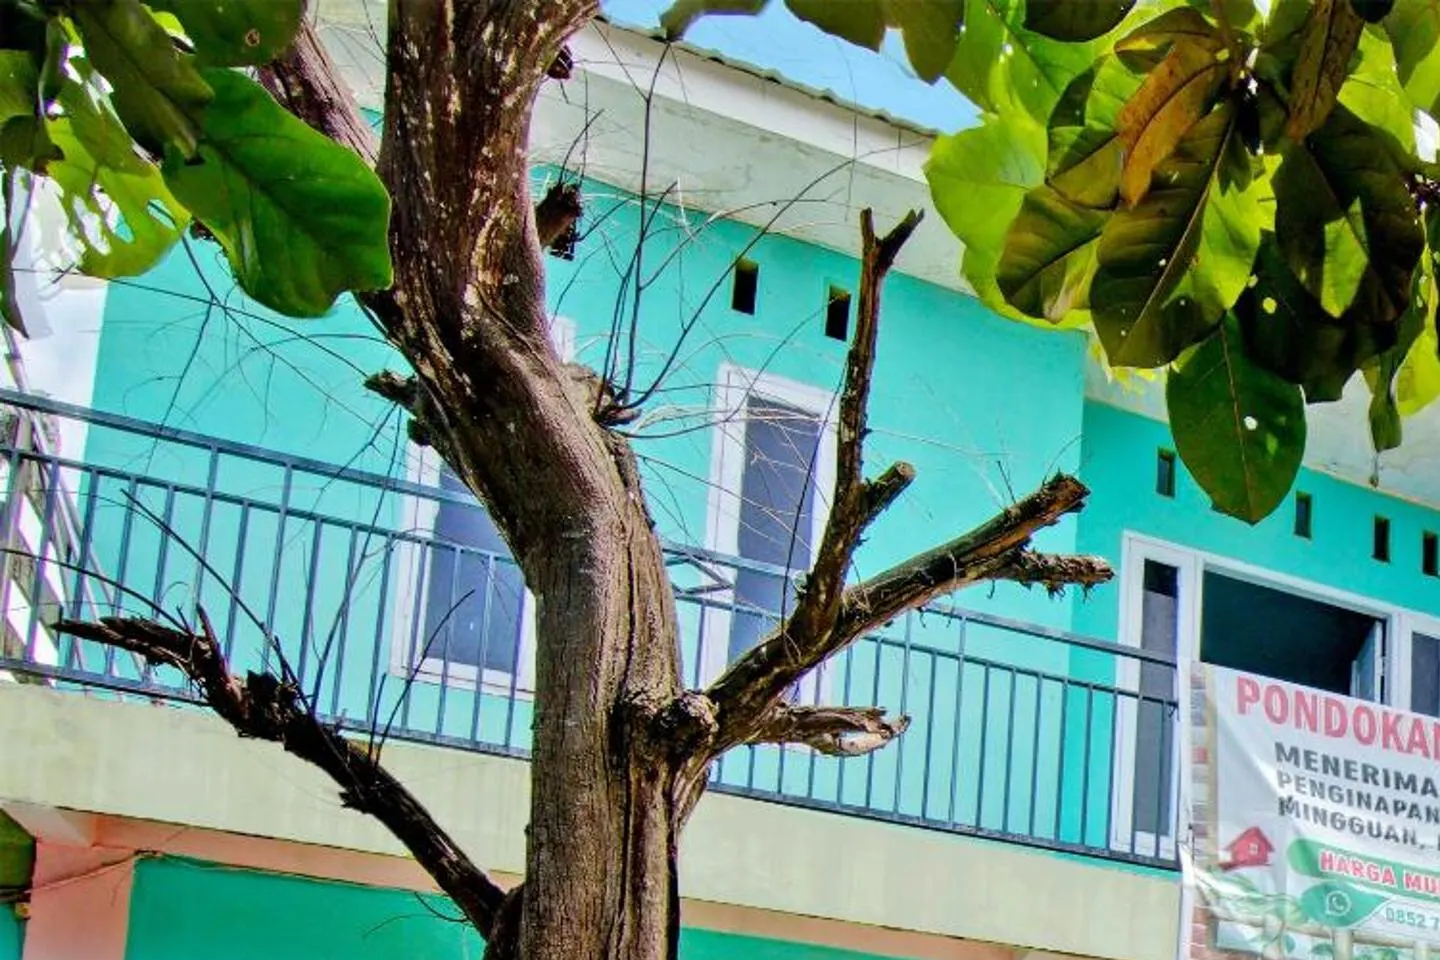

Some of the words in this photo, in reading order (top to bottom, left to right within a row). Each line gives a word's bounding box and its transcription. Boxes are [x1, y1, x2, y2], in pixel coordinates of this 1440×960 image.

[1274, 741, 1439, 799] MENERIMA
[1276, 769, 1440, 825] PENGINAPAN
[1320, 850, 1397, 886] HARGA
[1385, 906, 1428, 929] 0852
